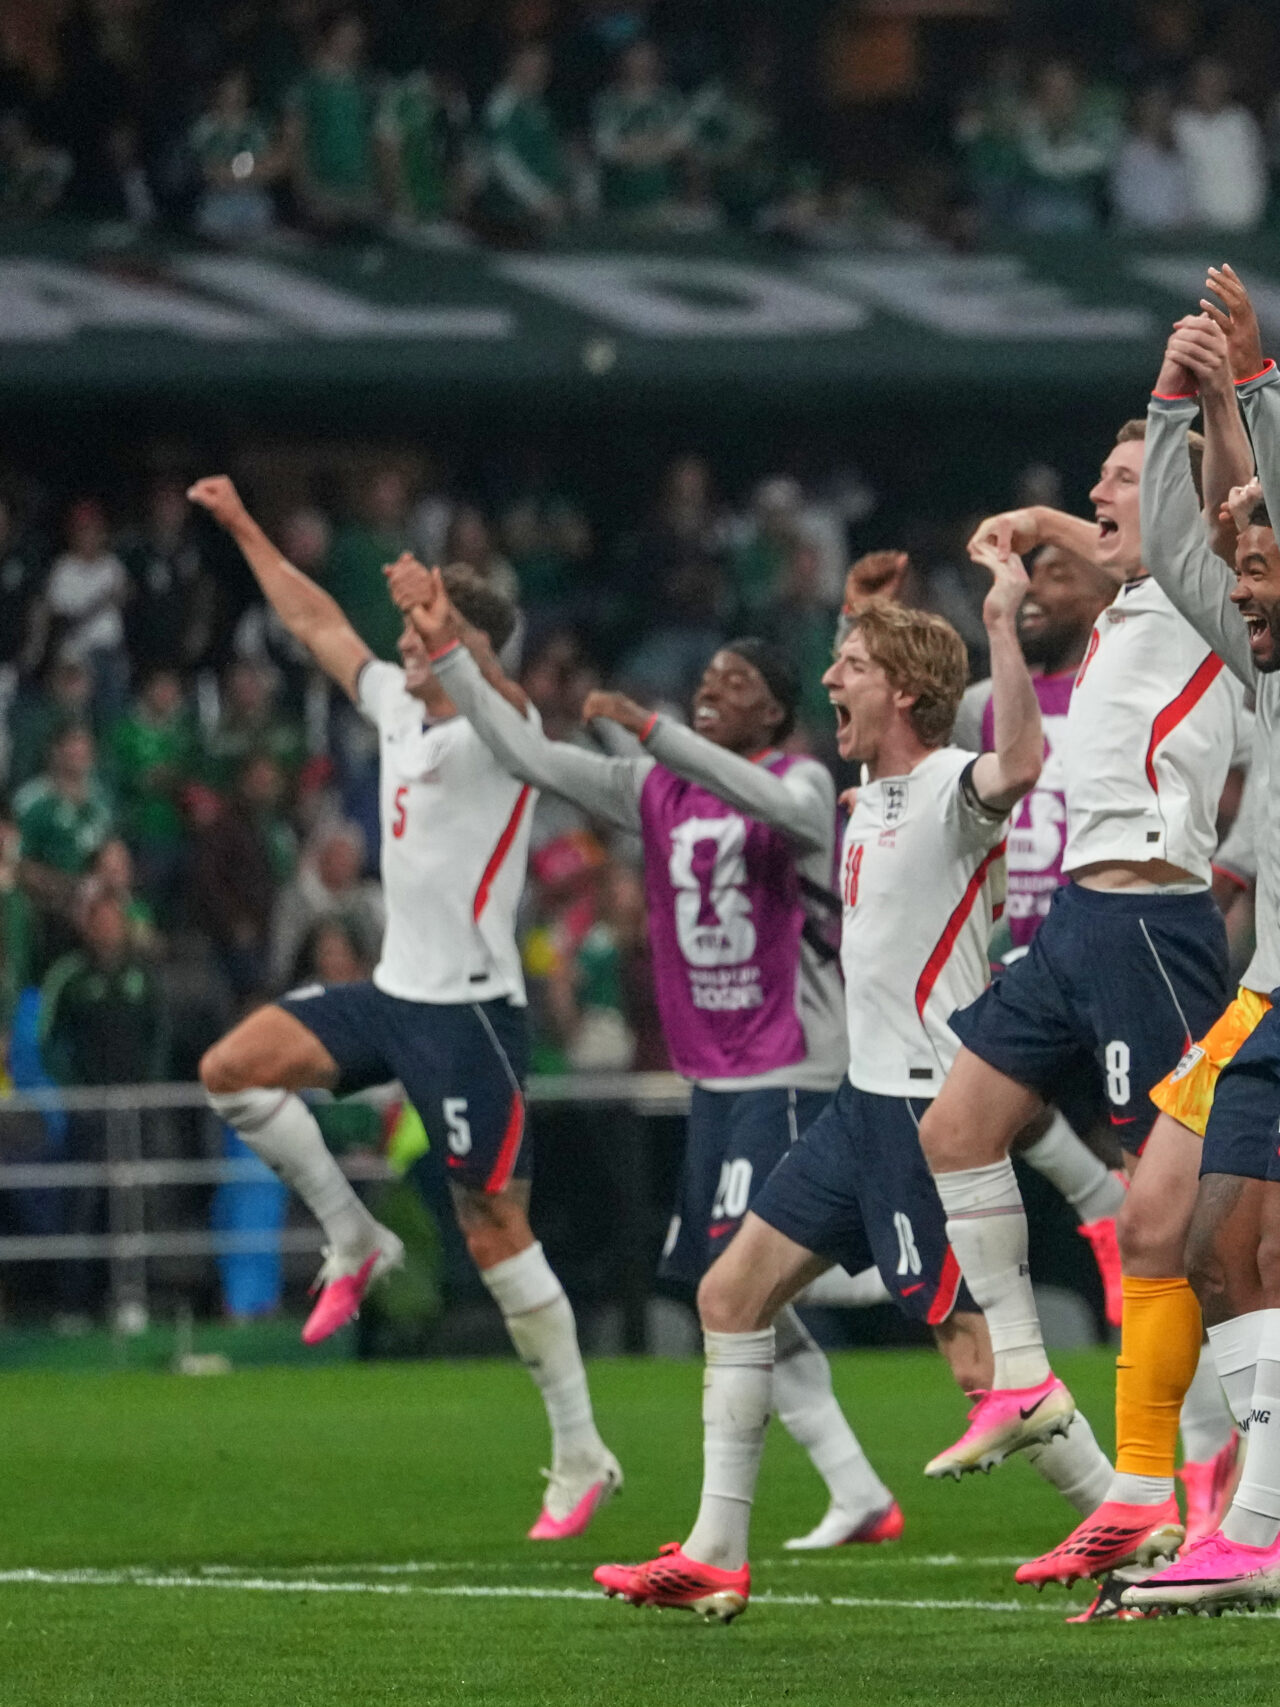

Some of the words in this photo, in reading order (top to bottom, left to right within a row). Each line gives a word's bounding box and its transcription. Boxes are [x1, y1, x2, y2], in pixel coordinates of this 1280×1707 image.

[392, 784, 409, 839] 5
[1104, 1040, 1131, 1106] 8
[442, 1096, 473, 1157] 5
[1250, 1408, 1271, 1425] NG
